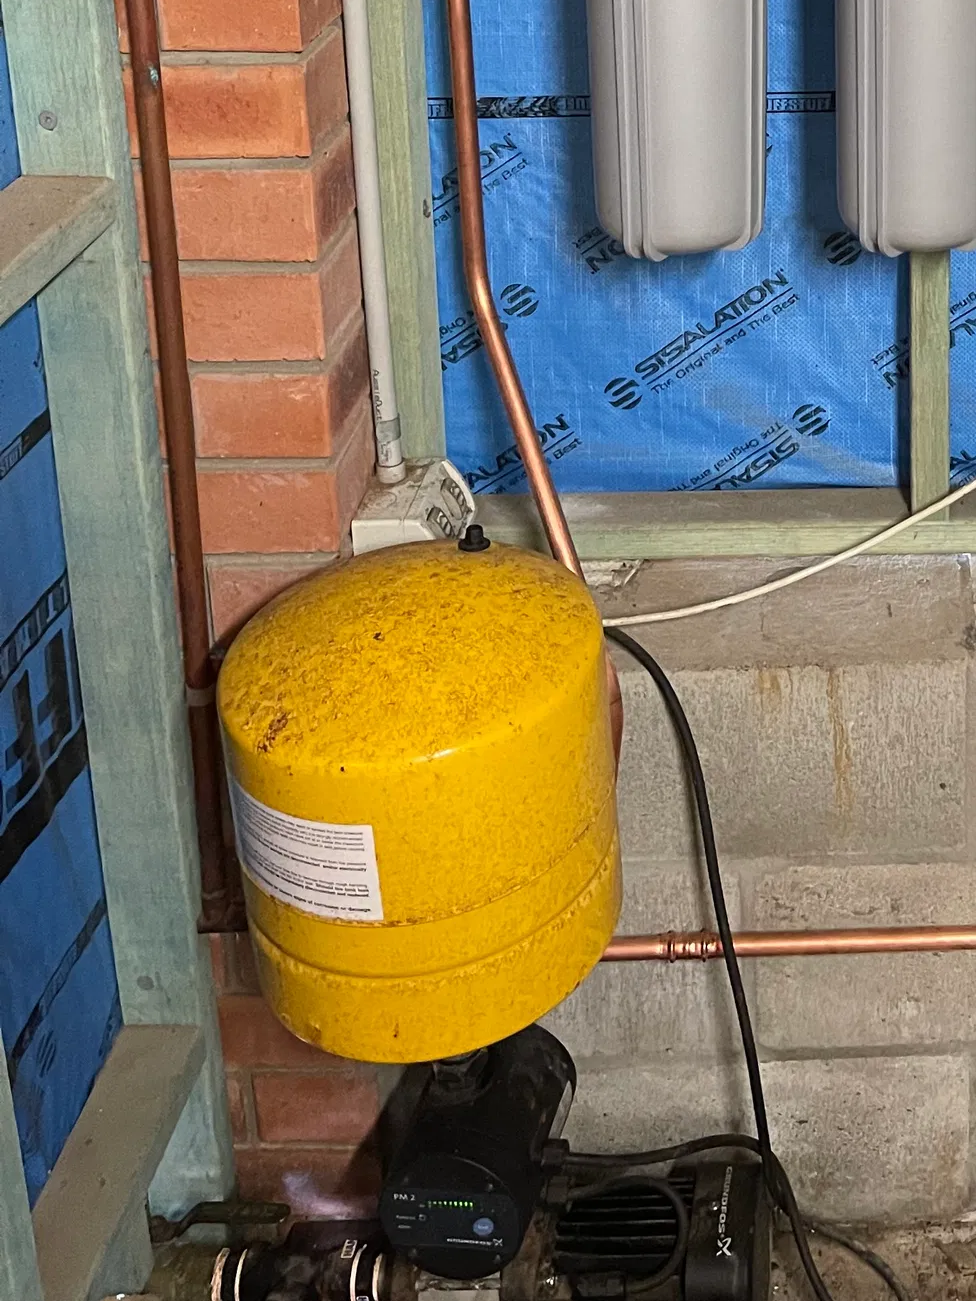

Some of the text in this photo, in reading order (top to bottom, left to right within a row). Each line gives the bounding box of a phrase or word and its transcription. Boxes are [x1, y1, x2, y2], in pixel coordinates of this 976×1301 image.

[502, 158, 530, 181] Best
[635, 269, 789, 381] SISALATION
[651, 292, 801, 395] The Original and The Best
[760, 421, 784, 440] The
[553, 437, 583, 460] Best
[714, 438, 760, 472] Original
[688, 468, 713, 486] and
[393, 1192, 416, 1202] PM 2
